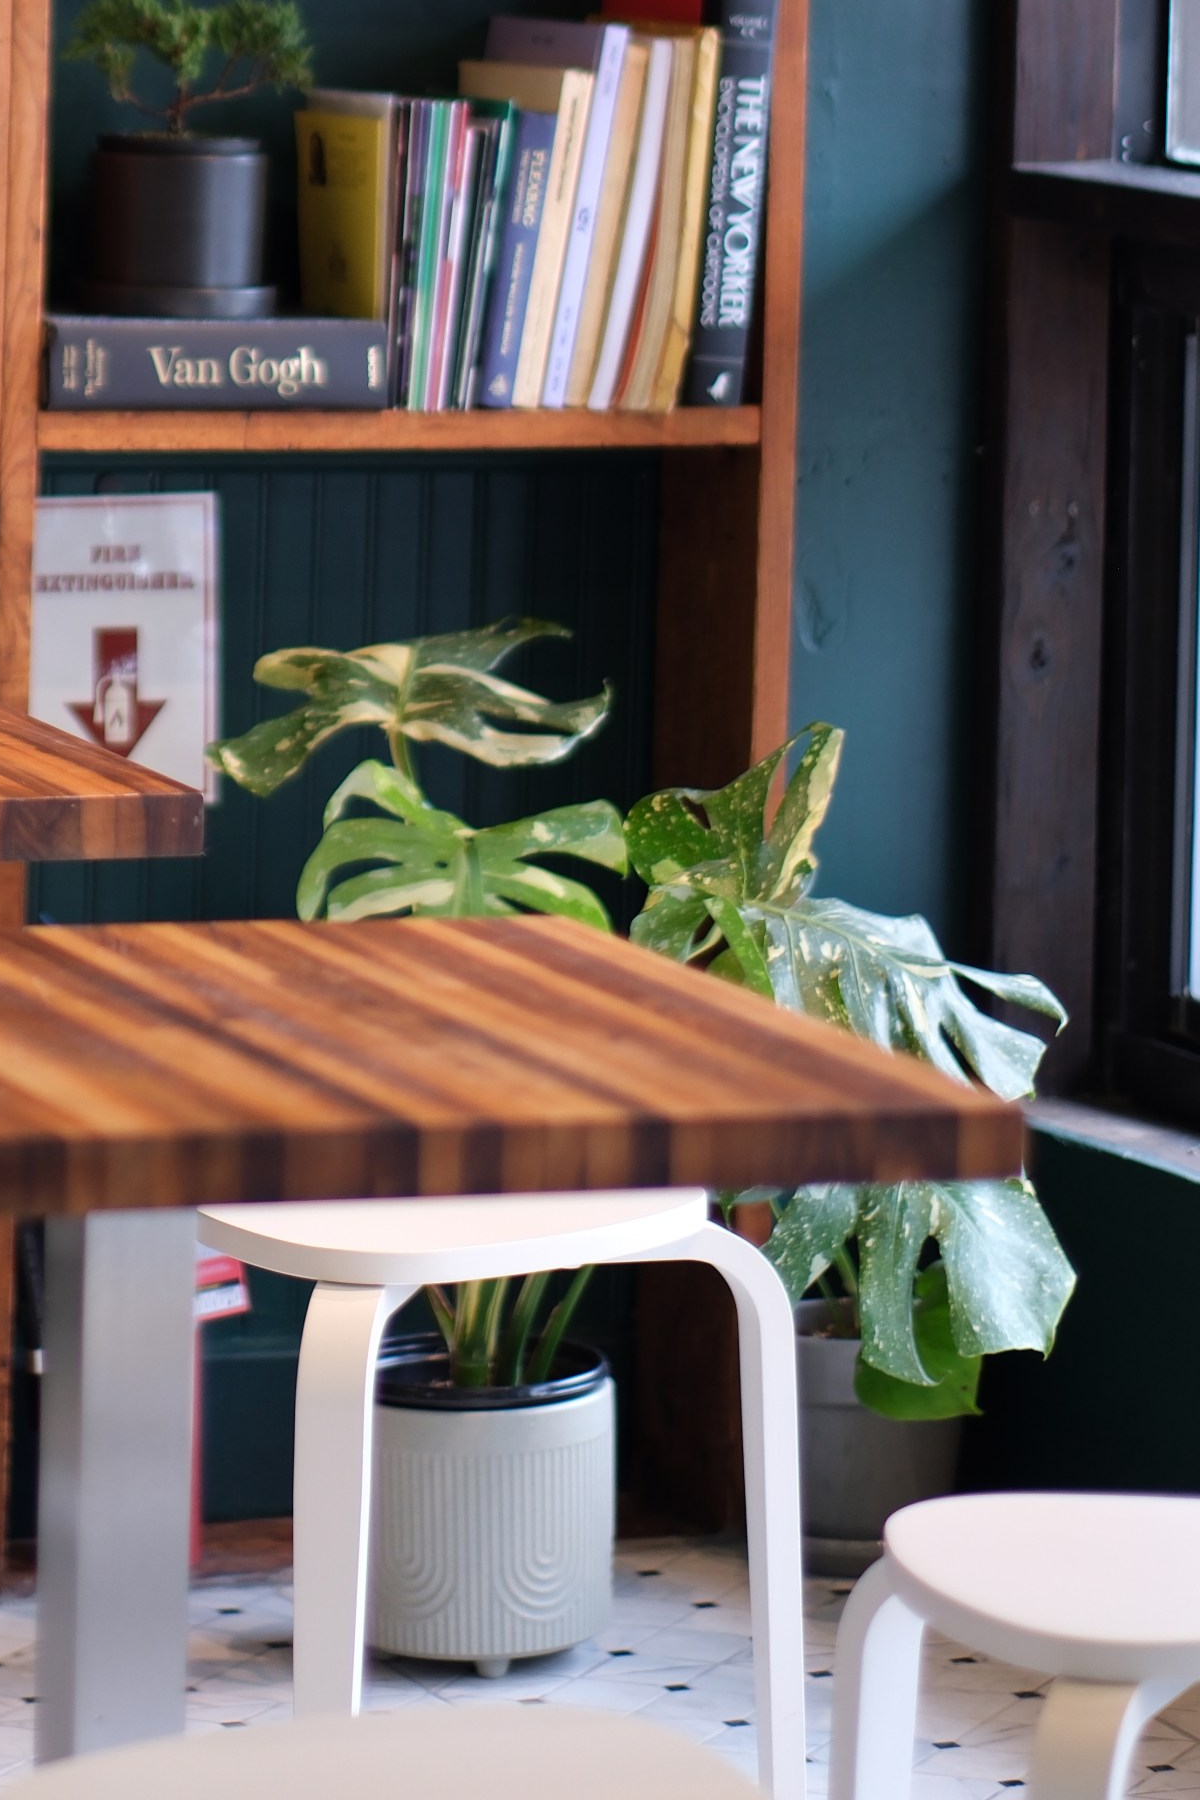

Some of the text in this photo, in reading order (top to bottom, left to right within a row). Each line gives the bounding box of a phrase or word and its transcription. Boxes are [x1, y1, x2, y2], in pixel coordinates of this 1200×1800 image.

[697, 76, 736, 329] ENCYCLOPEDIA OF CARTOONS
[714, 71, 767, 331] THE NEW YORKER
[149, 346, 327, 398] Van Gogh
[90, 543, 142, 563] FIRE
